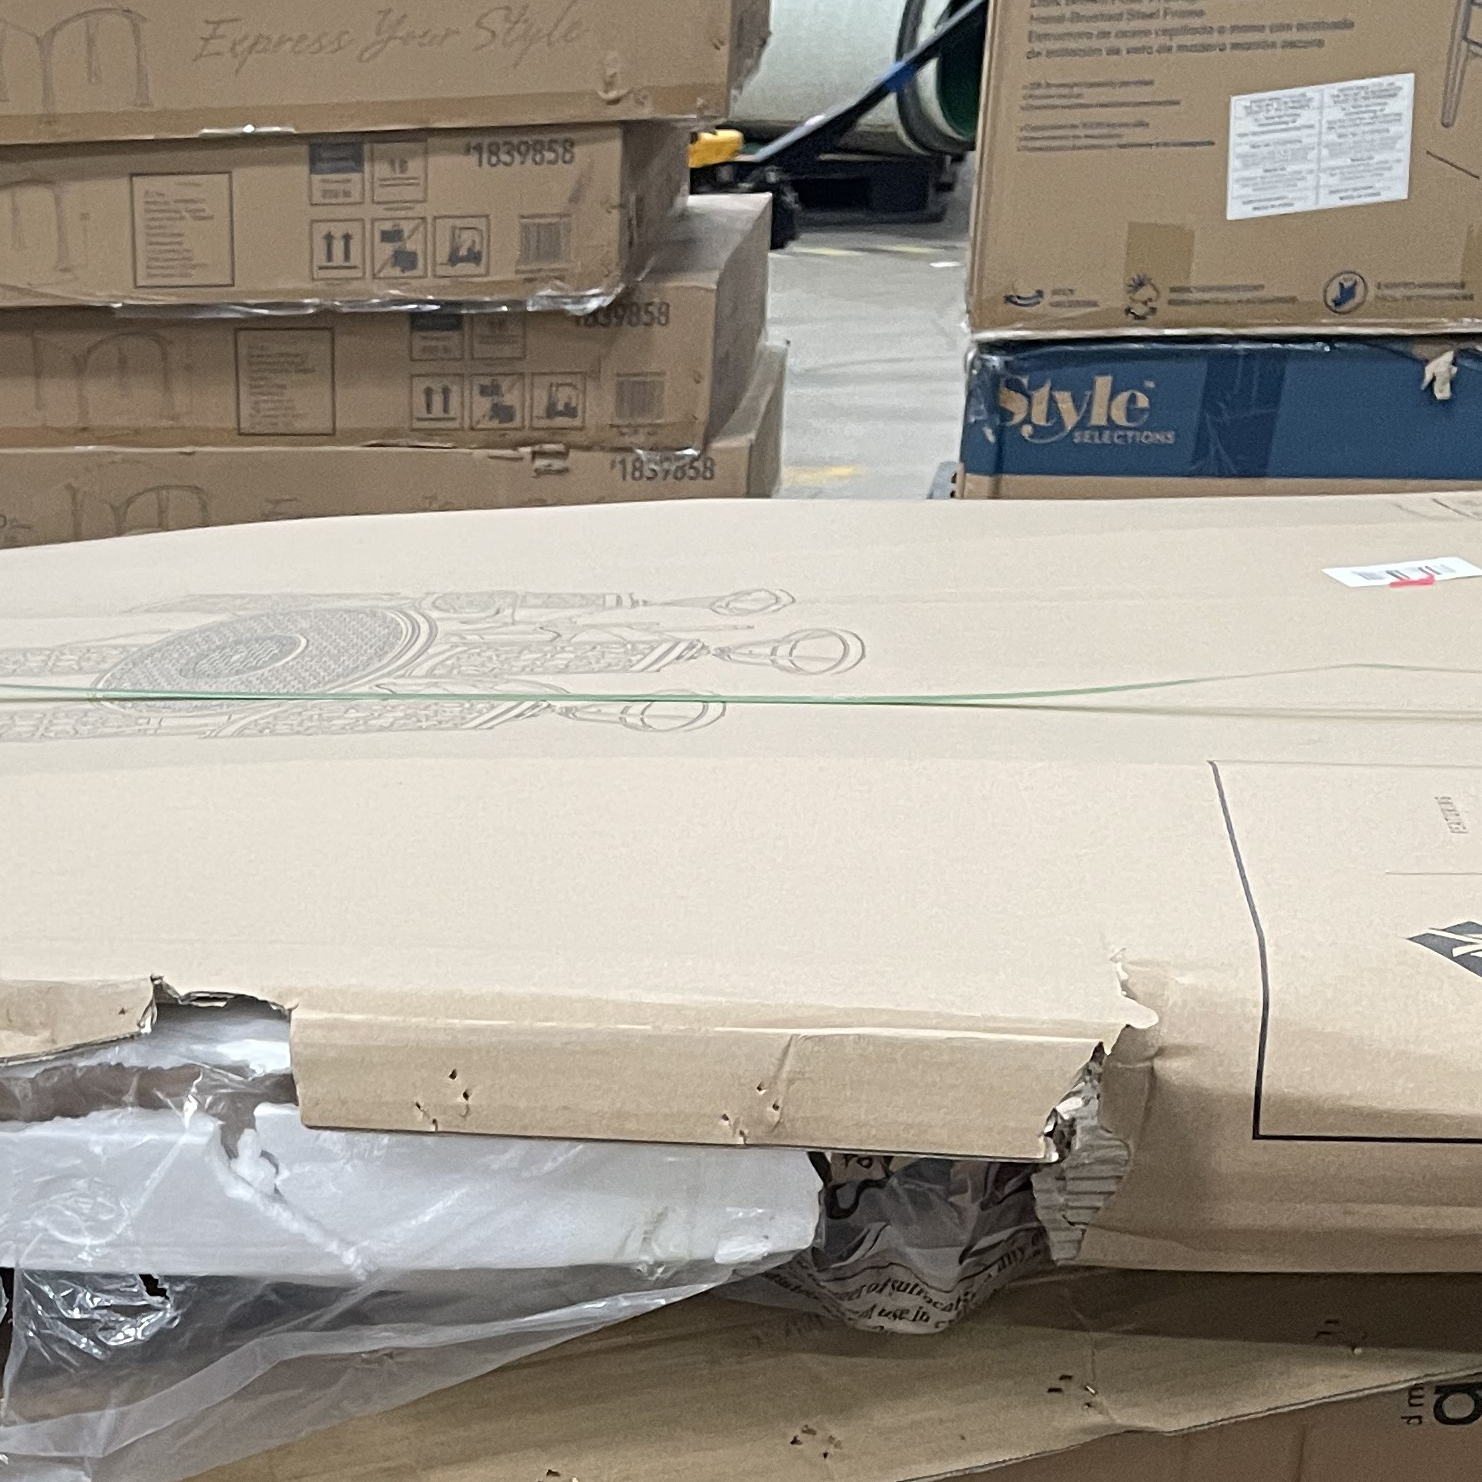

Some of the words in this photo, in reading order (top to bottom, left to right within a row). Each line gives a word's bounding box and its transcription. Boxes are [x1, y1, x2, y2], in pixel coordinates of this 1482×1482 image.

[357, 8, 460, 63] Your
[472, 0, 591, 68] Style
[998, 374, 1151, 444] Style
[1072, 429, 1176, 445] SELECTIONS
